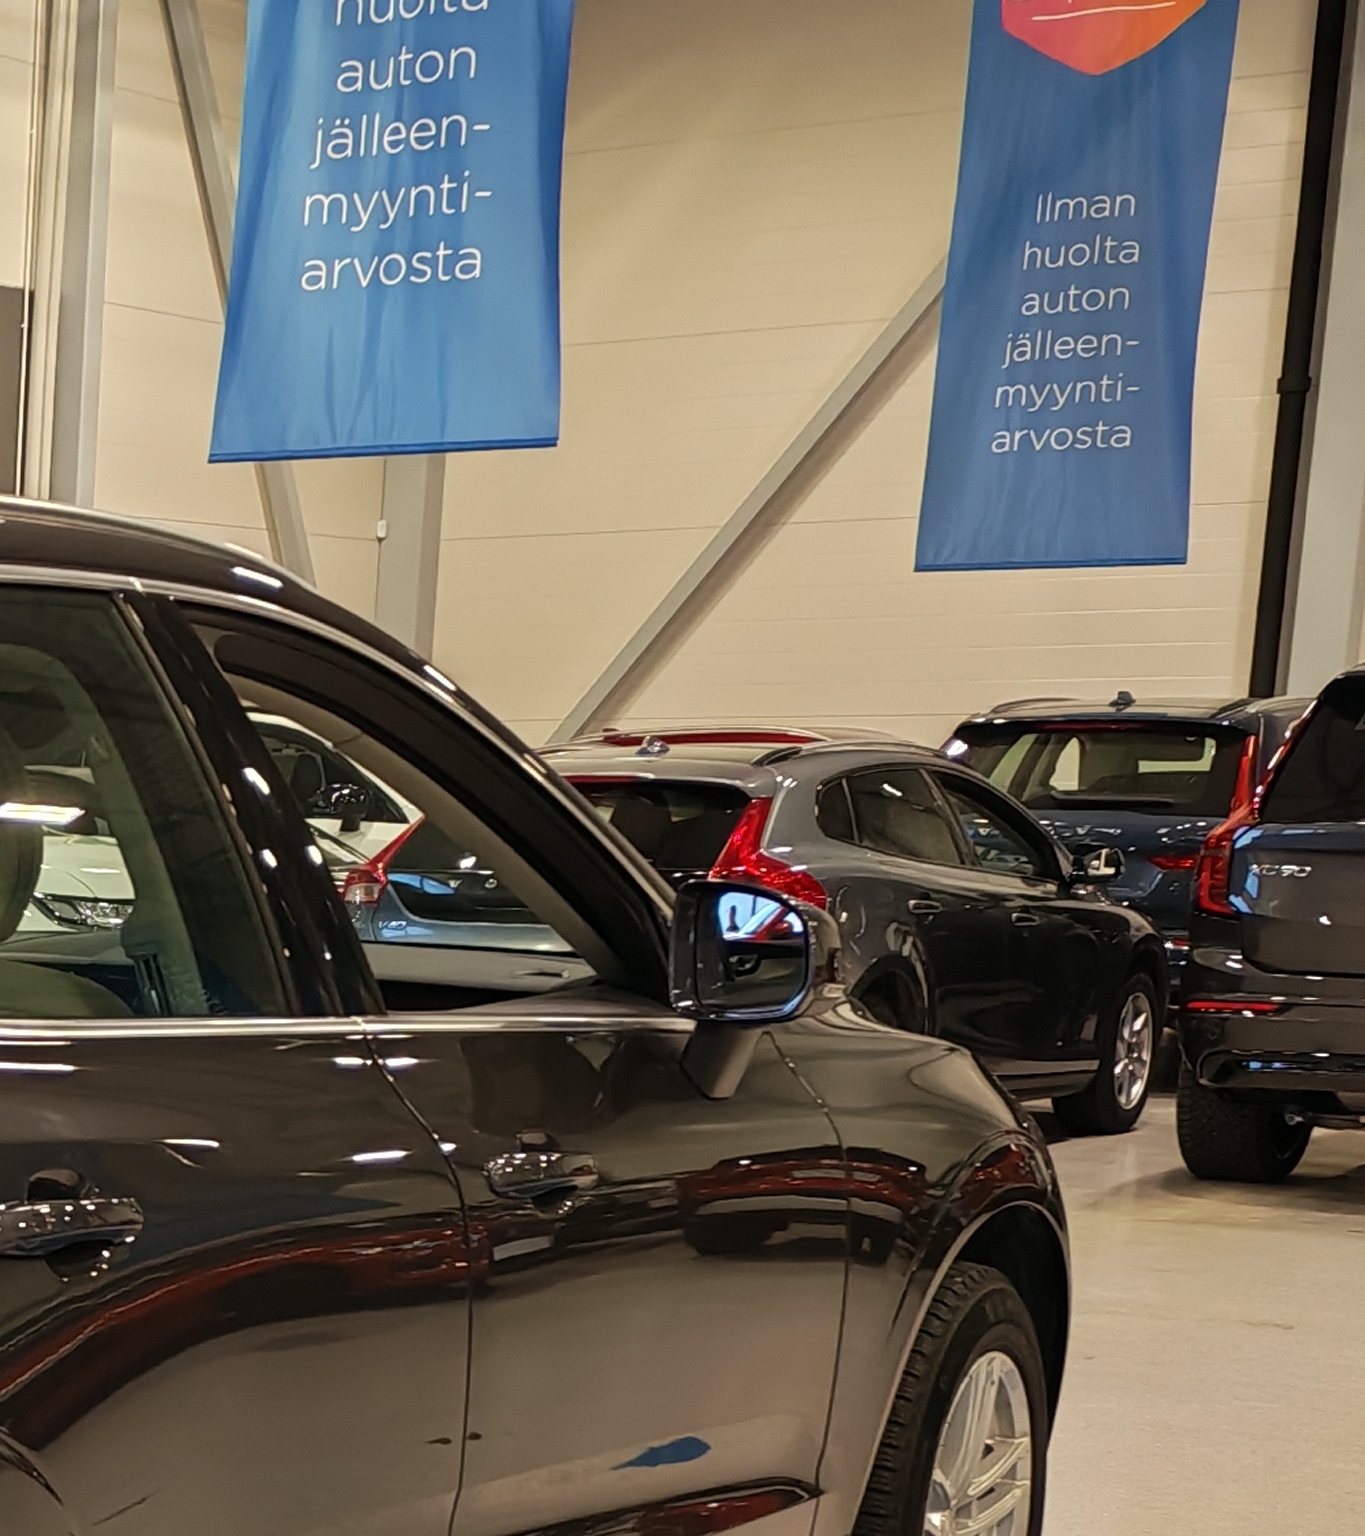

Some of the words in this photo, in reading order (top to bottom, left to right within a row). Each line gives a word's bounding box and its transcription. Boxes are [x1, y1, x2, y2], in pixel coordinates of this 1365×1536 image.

[336, 45, 478, 92] auton
[309, 112, 491, 169] jälleen-
[302, 170, 493, 232] myynti-
[1036, 192, 1136, 224] Ilman
[300, 240, 482, 291] arvosta
[1022, 235, 1140, 271] huolta
[1020, 284, 1130, 316] auton
[1000, 332, 1140, 369] jälleen-
[994, 373, 1141, 414] myynti-
[991, 421, 1132, 453] arvosta
[1249, 864, 1312, 877] XC90
